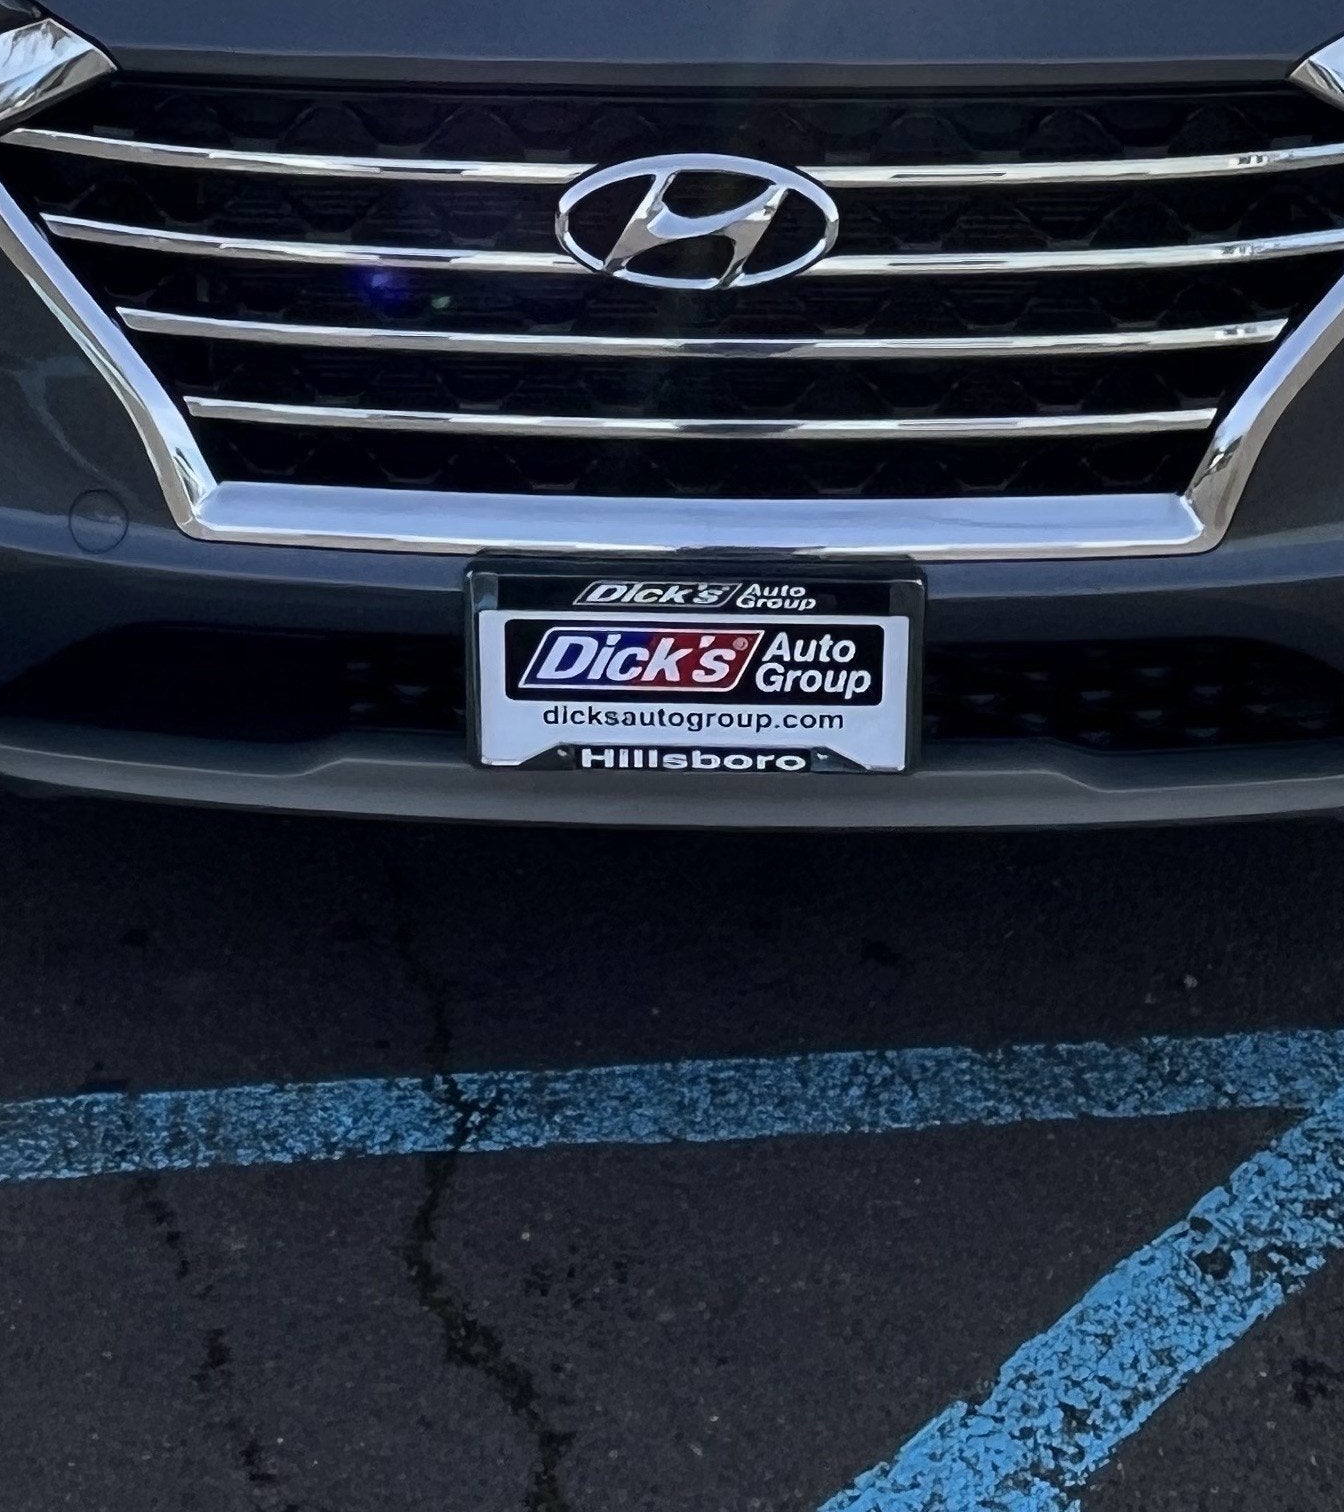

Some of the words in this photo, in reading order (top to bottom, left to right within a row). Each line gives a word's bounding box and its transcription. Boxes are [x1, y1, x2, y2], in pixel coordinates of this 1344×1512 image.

[744, 583, 806, 597] Auto
[736, 596, 817, 611] Group
[536, 634, 736, 683] Dick's
[762, 632, 856, 663] Auto
[755, 663, 872, 699] Group
[543, 706, 844, 732] dicksautogroup.com
[581, 748, 806, 771] Hillsboro
